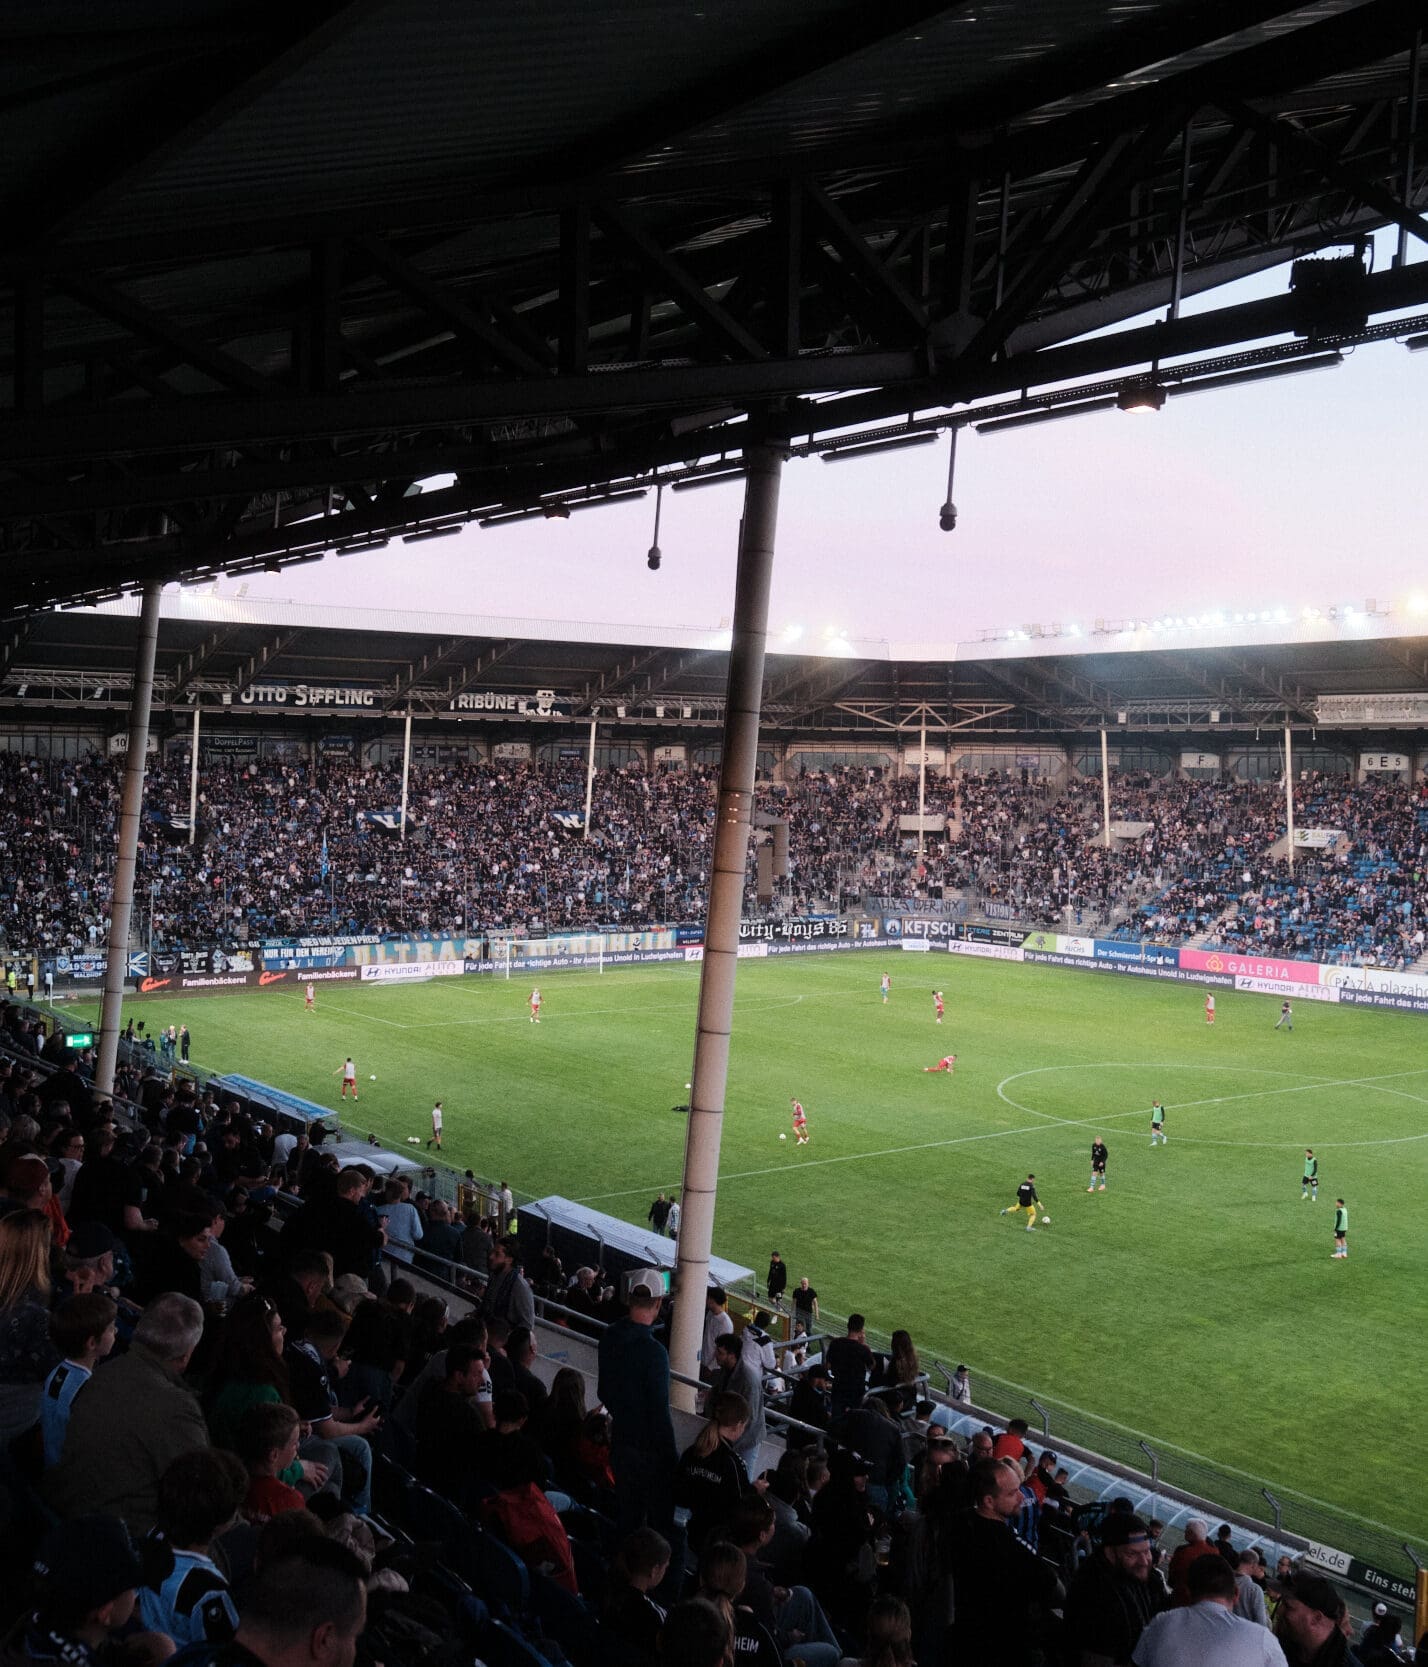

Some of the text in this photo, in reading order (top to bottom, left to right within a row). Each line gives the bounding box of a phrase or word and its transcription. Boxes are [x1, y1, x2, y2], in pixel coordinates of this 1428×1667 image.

[240, 685, 287, 704] OTTO
[1198, 755, 1205, 765] F
[1367, 756, 1401, 767] 6 E 5
[904, 920, 955, 936] KETSCH
[959, 926, 991, 935] BTTERIE
[319, 937, 332, 946] UM
[332, 935, 357, 946] JEDEN
[357, 935, 380, 944] PREIS
[768, 945, 779, 953] Für
[778, 945, 791, 954] jede
[791, 943, 806, 952] Fahrt
[806, 943, 817, 951] das
[817, 942, 837, 951] richtige
[838, 941, 851, 949] Auto
[862, 939, 887, 948] Autohaus
[263, 948, 279, 959] NUR
[280, 947, 294, 958] FÜR
[296, 947, 310, 957] DEN
[964, 944, 992, 953] HYUNDAI
[1097, 949, 1109, 957] Der
[465, 962, 478, 971] Für
[494, 960, 512, 969] Faht
[552, 957, 568, 967] Auto
[573, 956, 582, 965] Ihr
[583, 954, 613, 964] Autoaus
[614, 953, 633, 962] Unold
[634, 953, 640, 961] in
[640, 951, 683, 962] Ludwigshafen
[384, 966, 421, 975] HYUNDAI
[1025, 951, 1034, 960] Für
[1034, 952, 1046, 962] jede
[1047, 954, 1063, 964] Fahrt
[1063, 956, 1075, 966] das
[1075, 957, 1098, 968] richtige
[1098, 960, 1113, 970] Auto
[1117, 963, 1126, 972] Ihr
[1127, 964, 1157, 976] Autohaus
[1158, 968, 1178, 978] Unold
[1178, 970, 1185, 979] in
[1186, 972, 1233, 985] Ludwigshafen
[1228, 961, 1289, 979] GALERIA
[182, 975, 247, 987] Familienbäckerei
[297, 969, 357, 981] Familienbäckerei
[1257, 981, 1295, 992] HYUNDAI
[1335, 977, 1375, 993] PAZA
[1340, 991, 1355, 1001] Für
[1355, 992, 1373, 1004] jede
[1374, 994, 1395, 1005] Fahrt
[1396, 998, 1412, 1008] das
[1308, 1546, 1345, 1569] els.de
[1364, 1569, 1416, 1600] Eins steh
